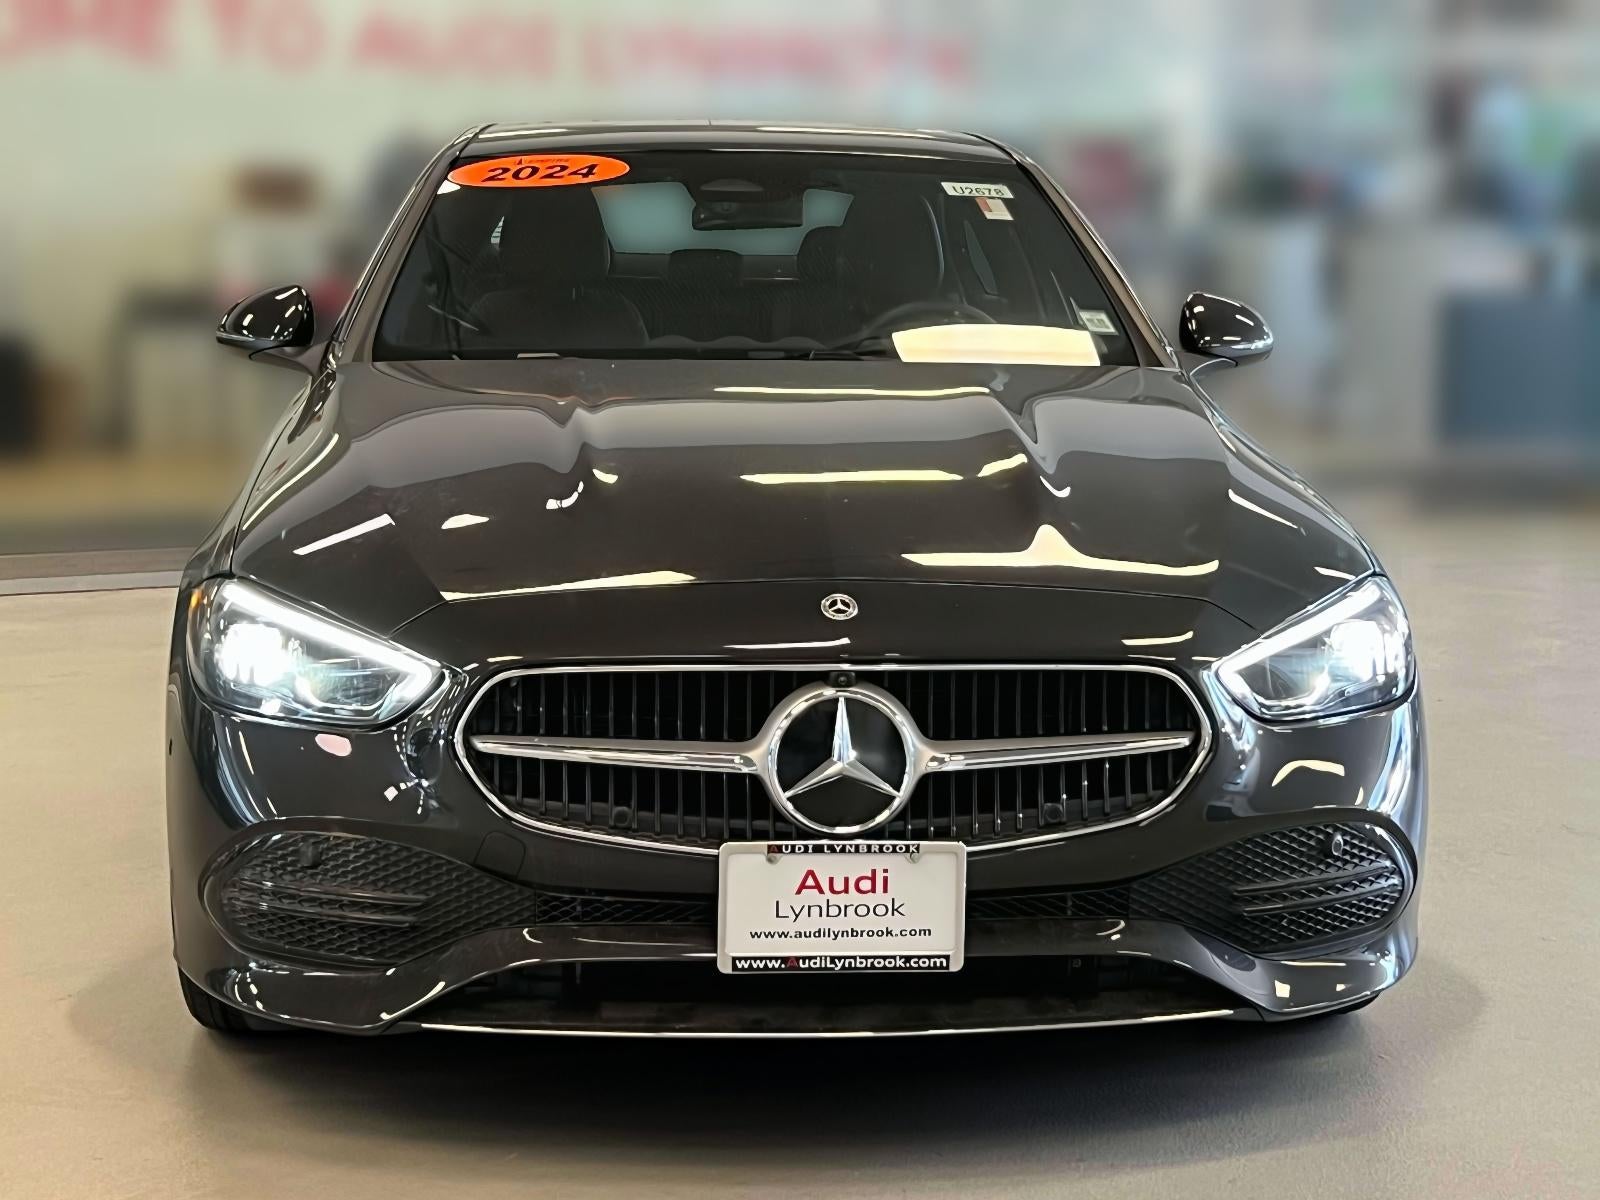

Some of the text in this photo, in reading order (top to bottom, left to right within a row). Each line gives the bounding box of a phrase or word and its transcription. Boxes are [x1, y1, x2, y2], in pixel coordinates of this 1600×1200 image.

[480, 164, 599, 183] 2024
[952, 185, 1005, 197] U2678
[768, 844, 919, 854] AUDI LYNBROOK
[795, 868, 889, 895] Audi
[775, 898, 906, 922] Lynbrook
[749, 927, 932, 940] www.audilynbrook.com
[735, 955, 947, 970] www.AudiLynbrook.com
